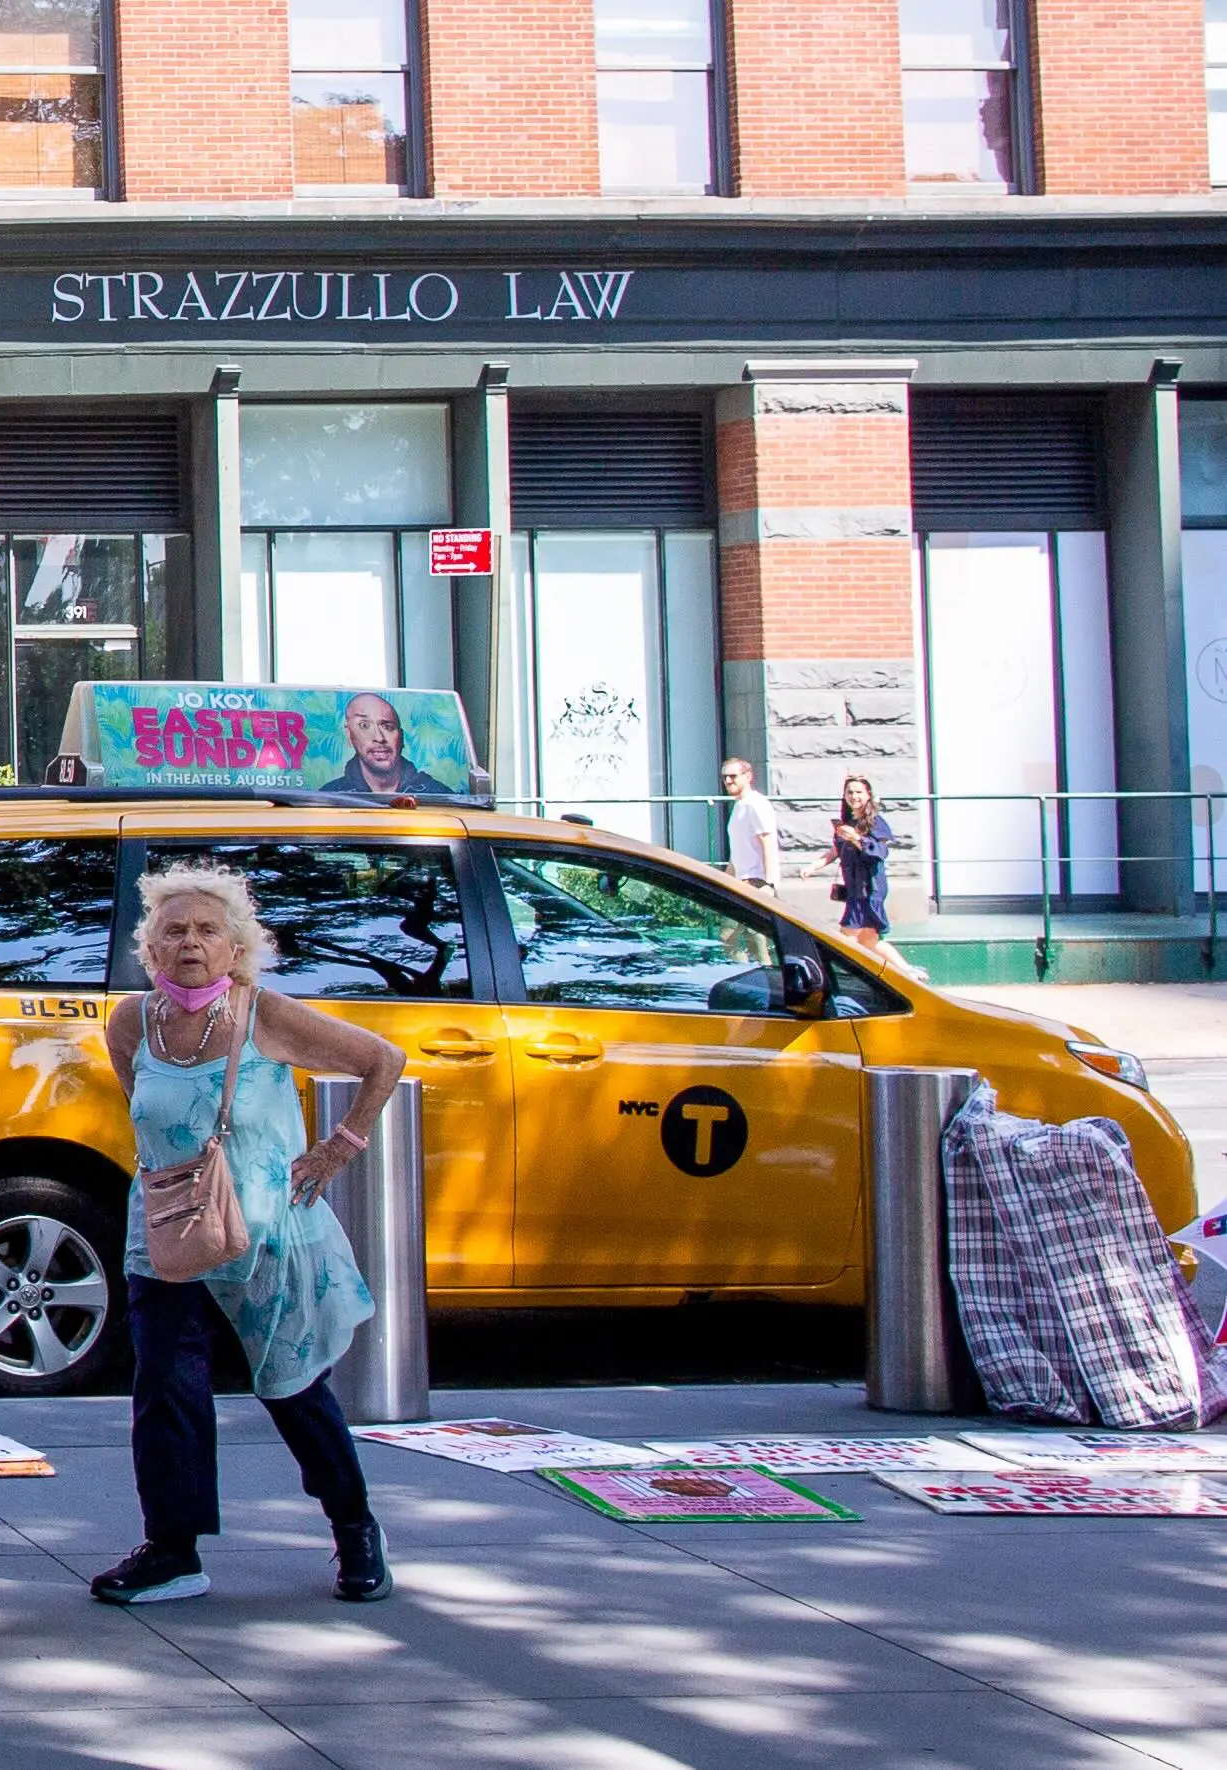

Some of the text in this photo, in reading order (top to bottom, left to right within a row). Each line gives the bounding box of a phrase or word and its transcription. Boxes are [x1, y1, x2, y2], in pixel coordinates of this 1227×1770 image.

[51, 270, 635, 323] STRAZZULLO LAW
[432, 533, 482, 543] NO STANDING
[65, 605, 88, 620] 391
[176, 692, 255, 710] JO KOY
[132, 707, 307, 740] EASTER
[134, 735, 309, 770] SUNDAY
[145, 771, 304, 788] IN THEATERS AUGUST 5
[618, 1099, 729, 1166] NYC T
[922, 1486, 1015, 1496] NO
[981, 1502, 1055, 1511] IN
